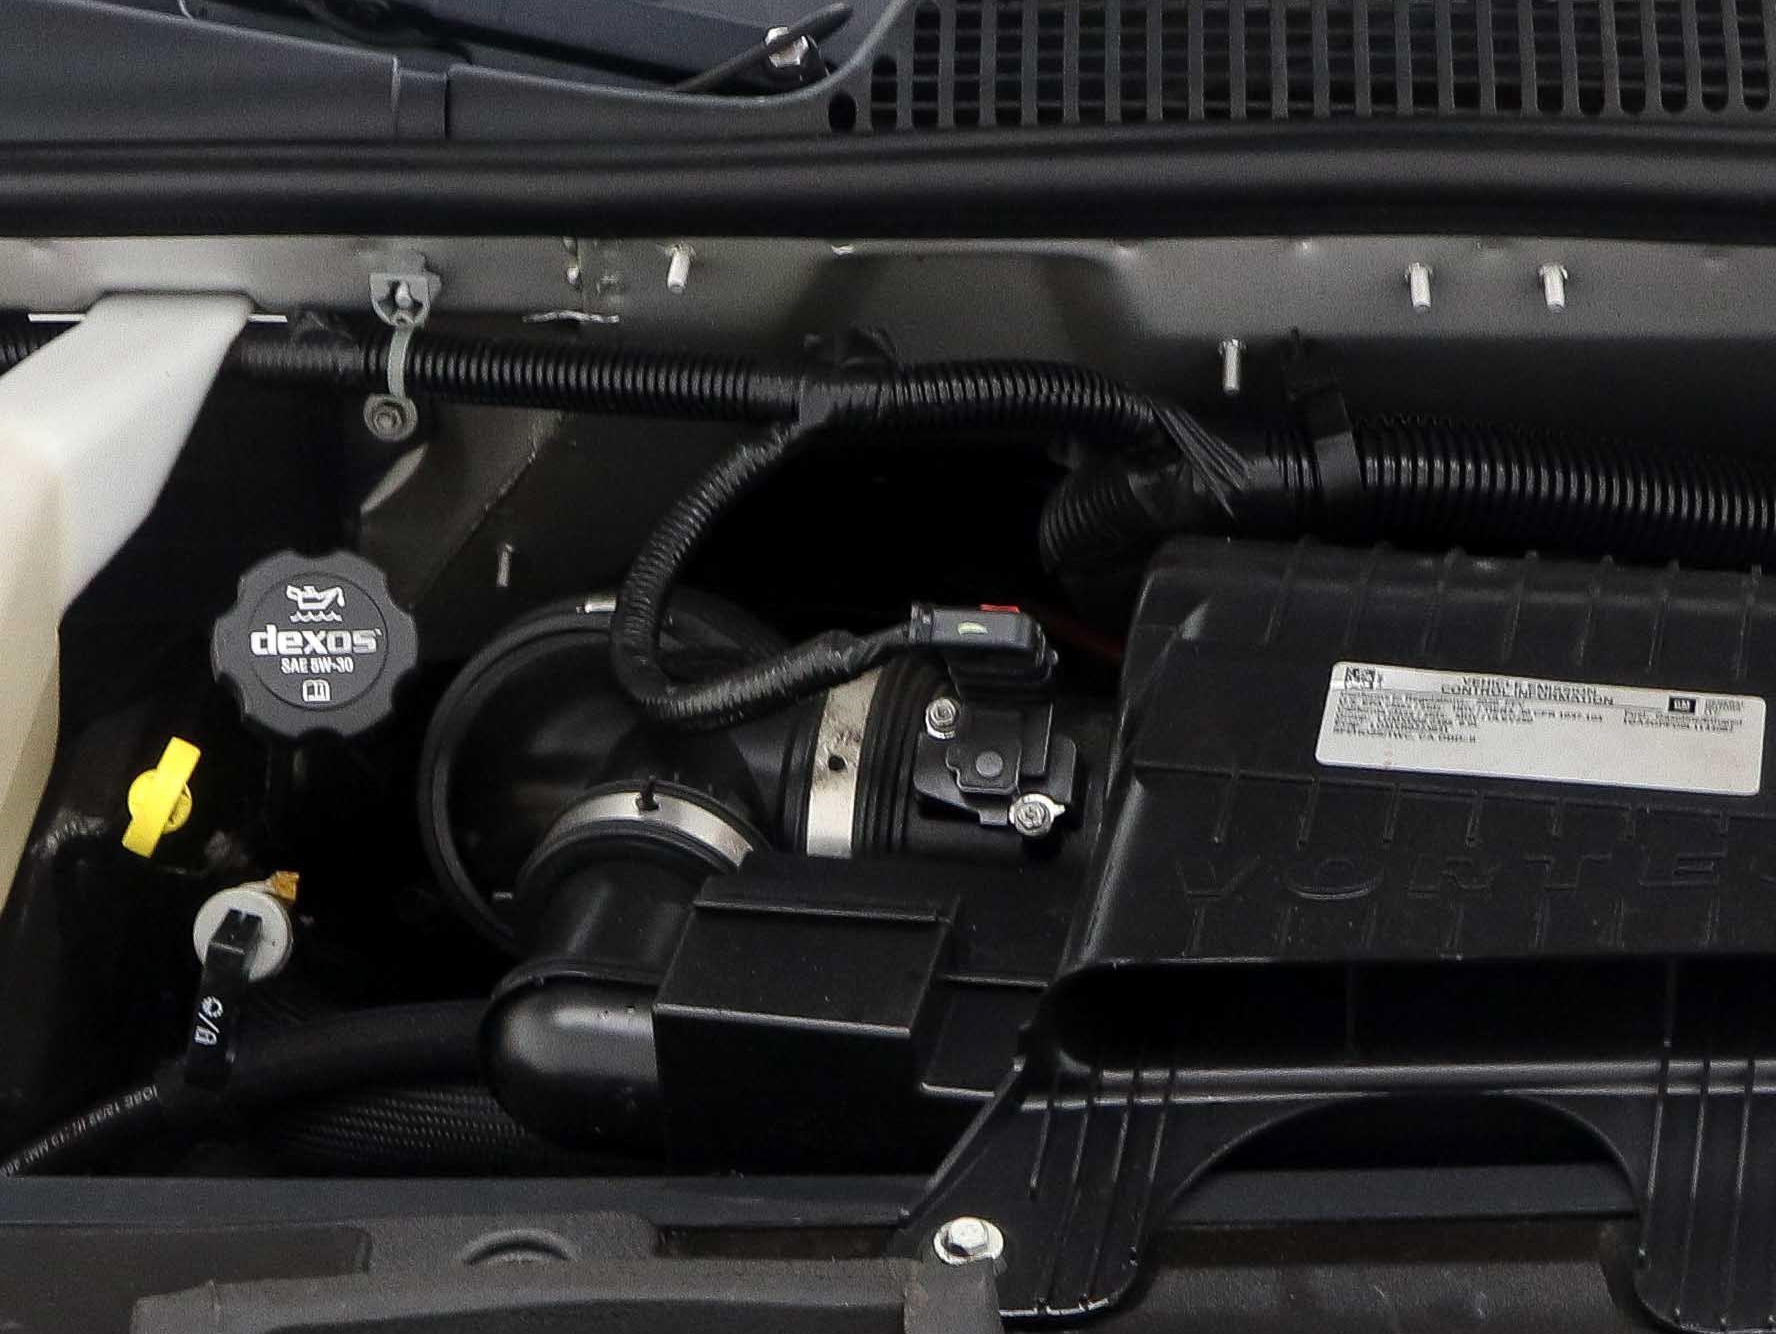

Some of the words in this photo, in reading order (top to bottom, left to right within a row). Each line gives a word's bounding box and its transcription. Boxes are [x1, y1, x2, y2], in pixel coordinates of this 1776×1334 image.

[249, 624, 377, 656] dexos
[281, 657, 308, 674] SAE
[310, 657, 354, 673] 5W-30
